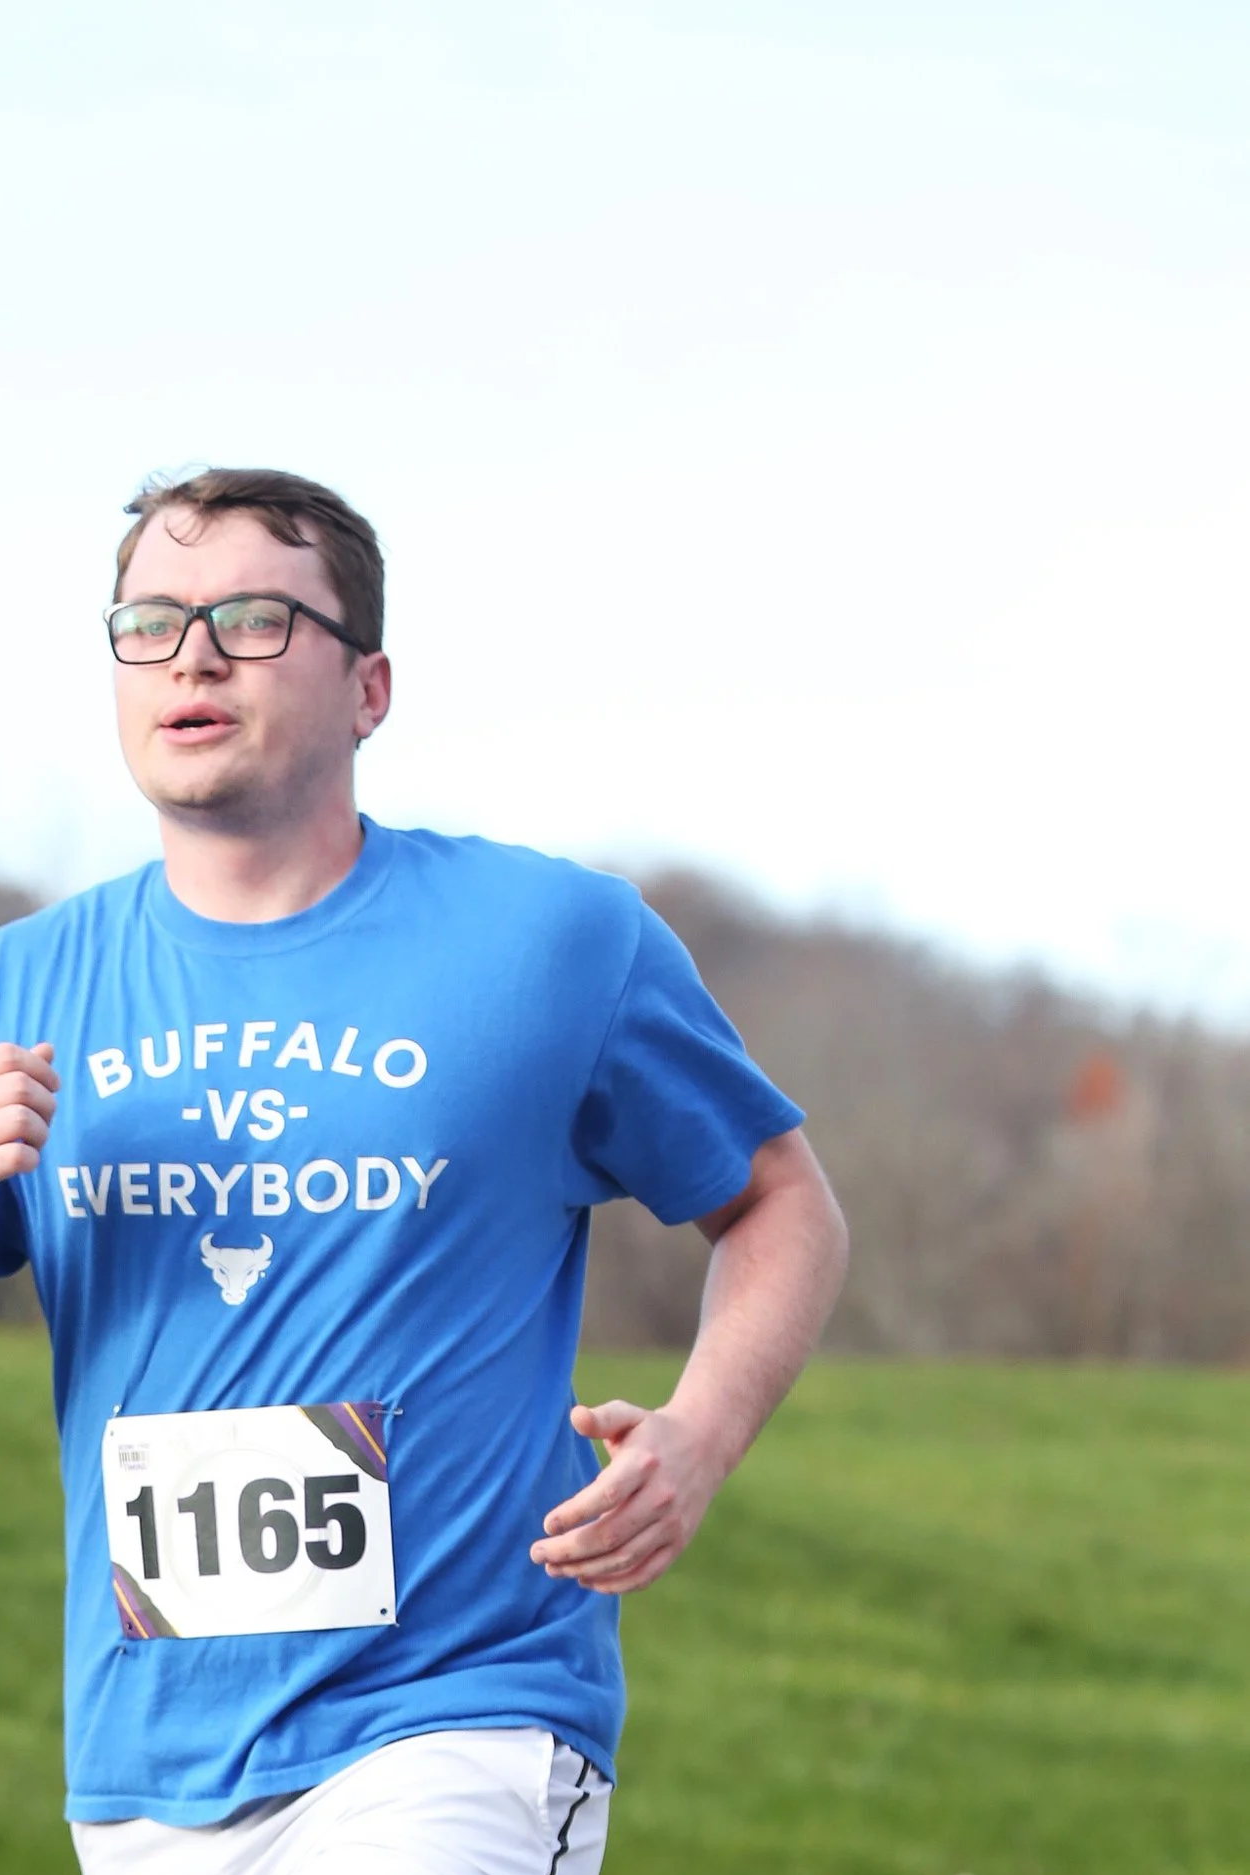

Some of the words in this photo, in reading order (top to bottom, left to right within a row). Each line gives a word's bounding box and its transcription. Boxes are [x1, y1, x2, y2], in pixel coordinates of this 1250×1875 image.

[87, 1021, 428, 1099] BUFFALO
[58, 1156, 449, 1218] EVERYBODY
[126, 1473, 367, 1580] 1165
